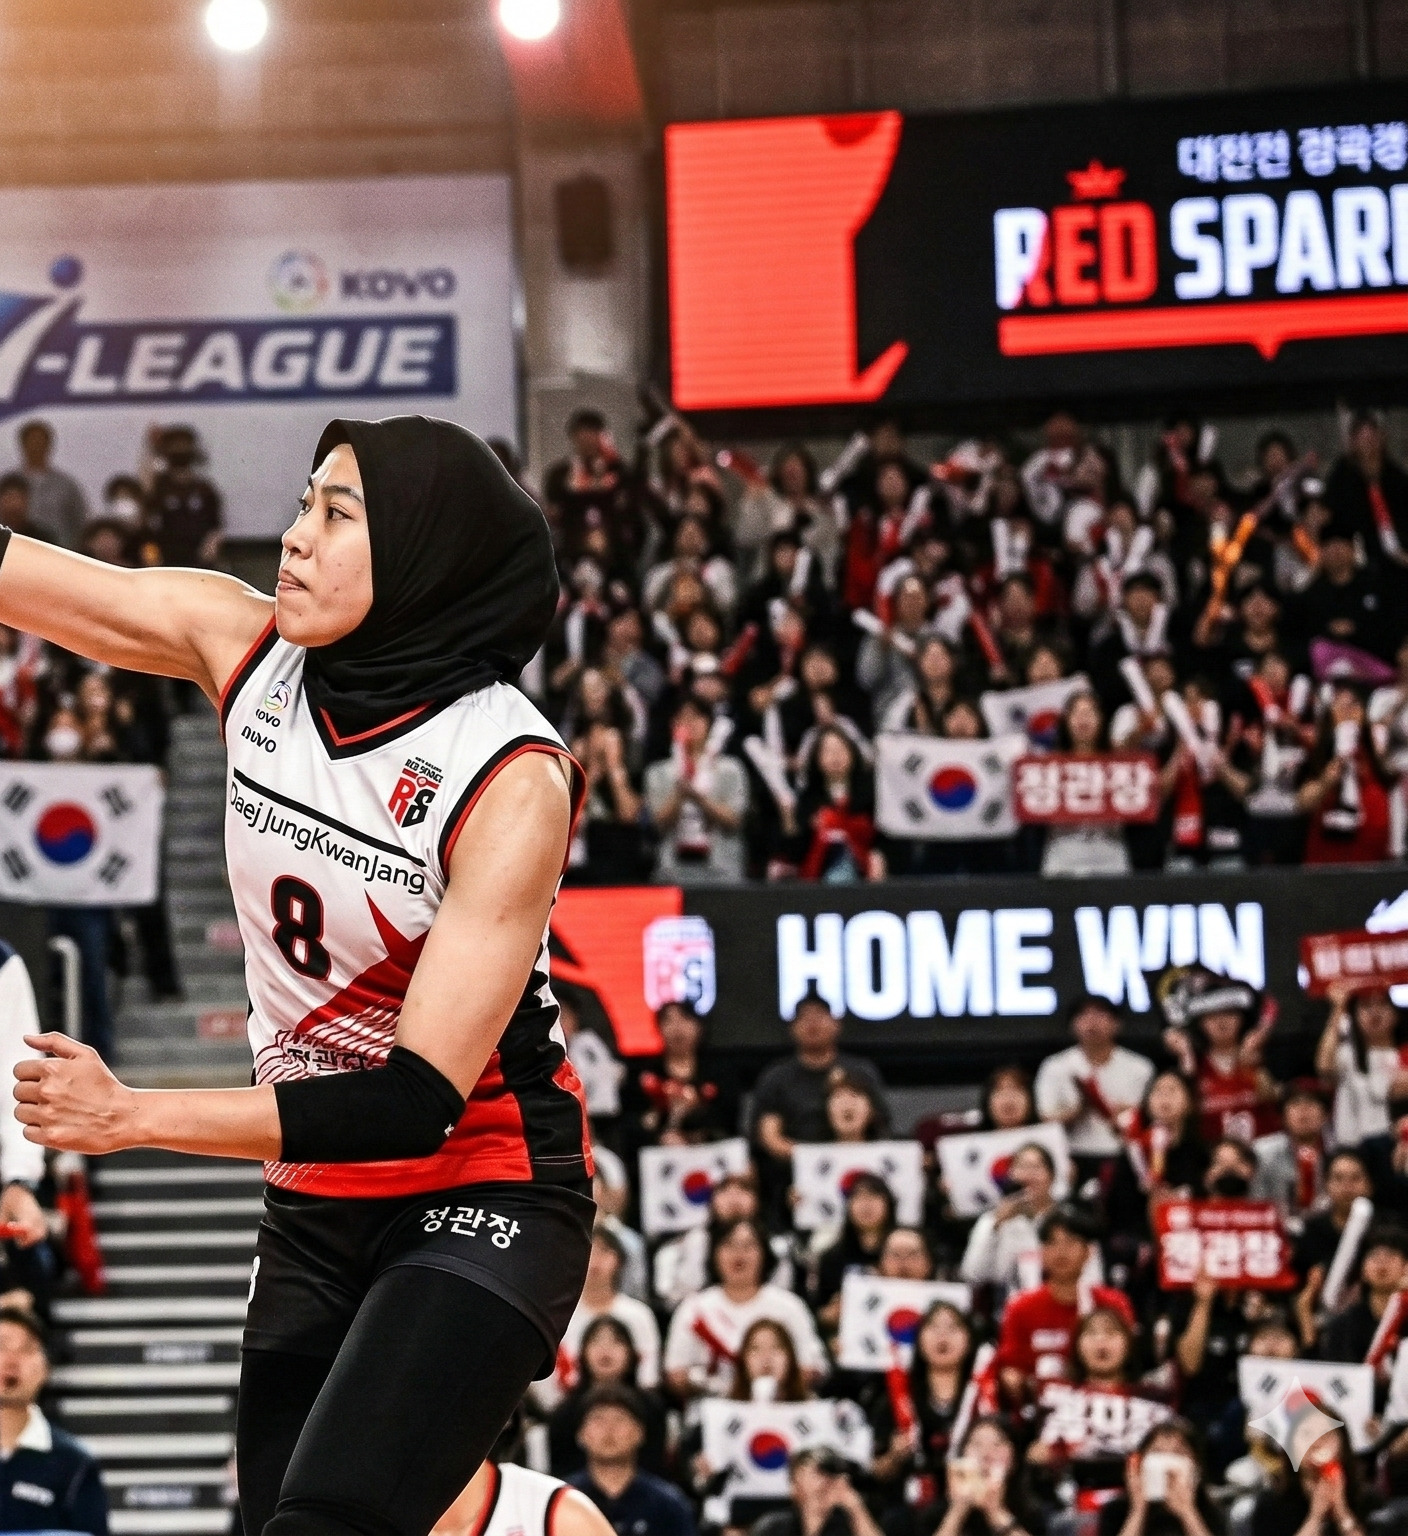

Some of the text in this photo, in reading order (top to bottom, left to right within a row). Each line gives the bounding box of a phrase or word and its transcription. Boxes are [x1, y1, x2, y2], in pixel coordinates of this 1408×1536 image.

[338, 267, 457, 301] KOVO
[994, 201, 1159, 311] RED
[255, 708, 281, 728] OVO
[270, 874, 332, 982] 8
[776, 901, 1266, 1021] HOME WIN
[420, 1205, 522, 1250] 정관장
